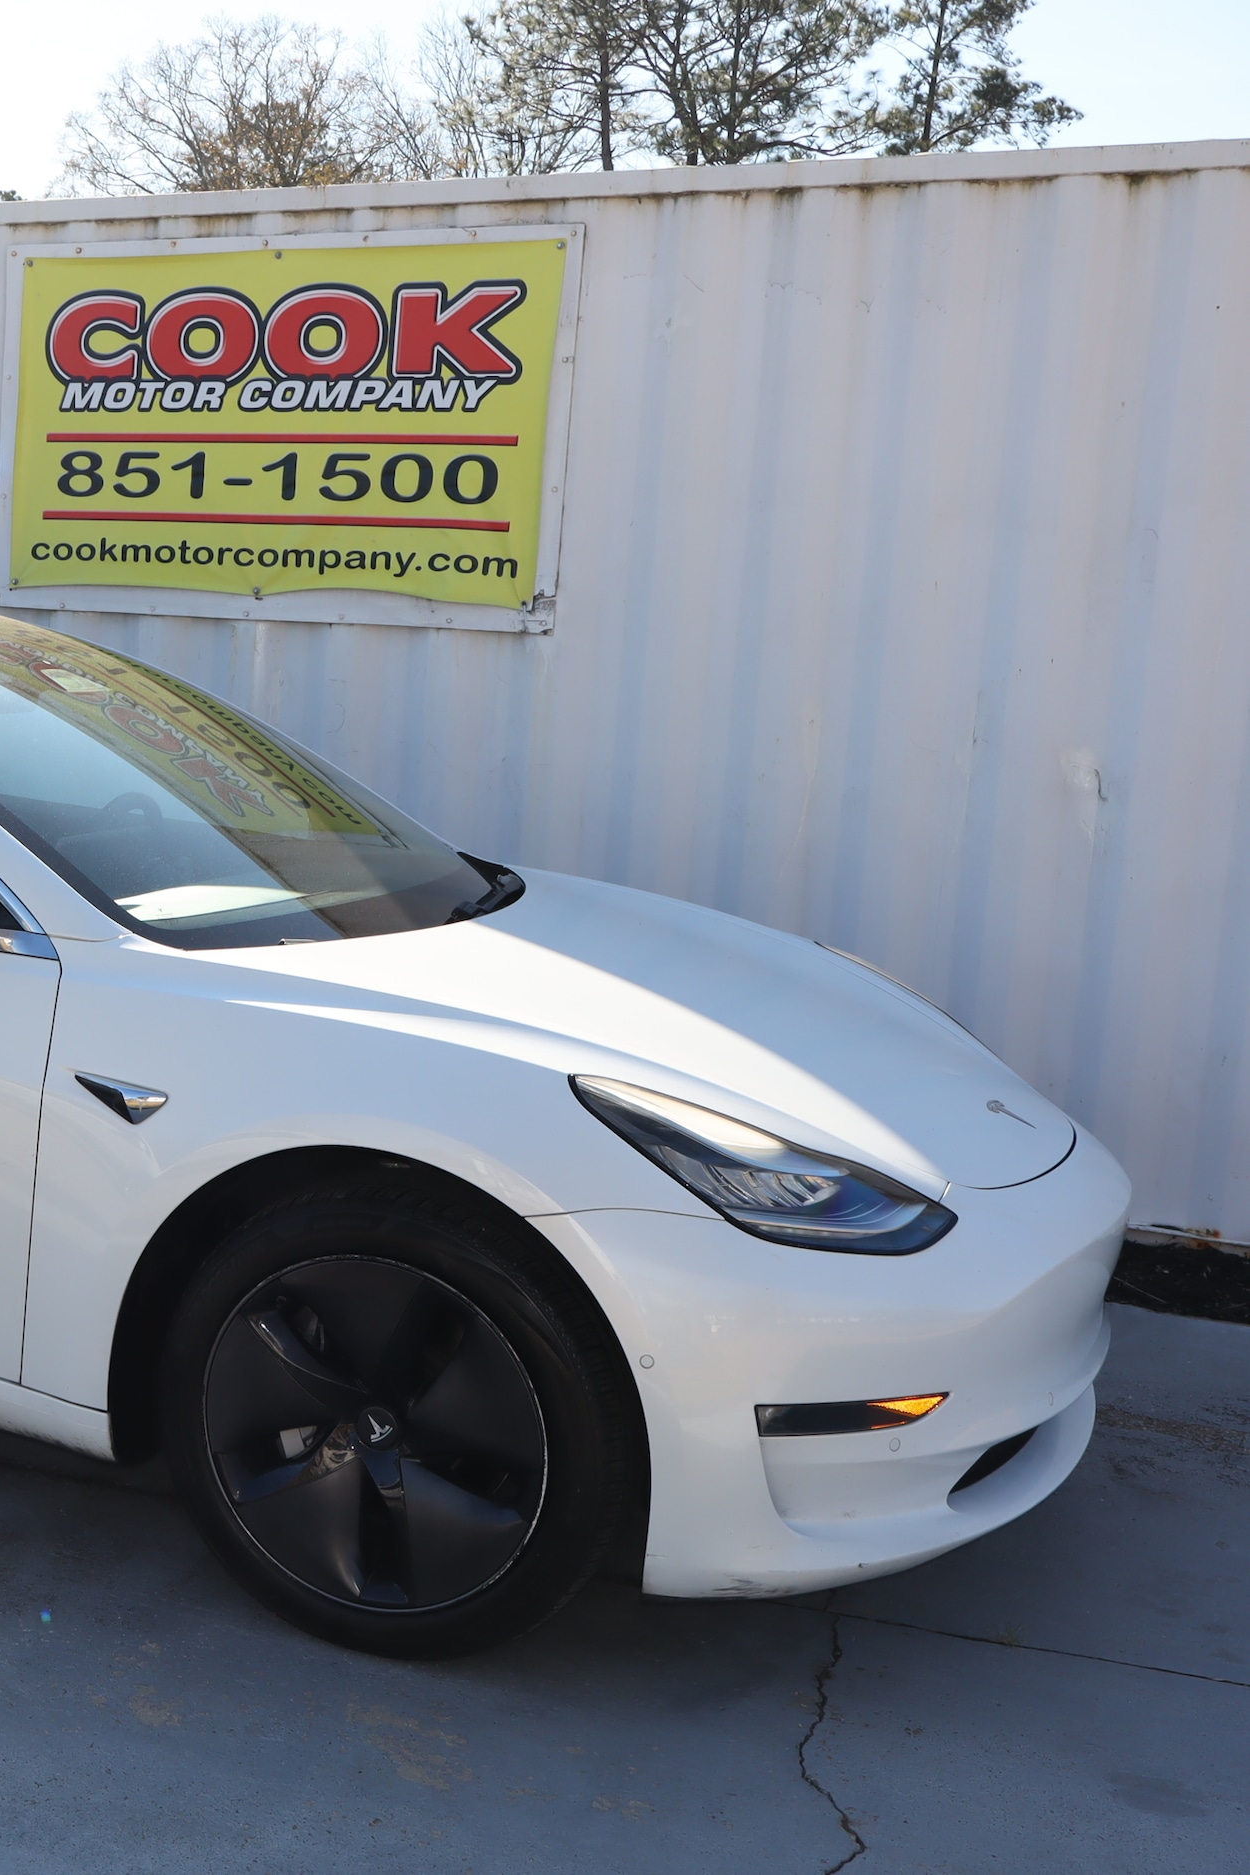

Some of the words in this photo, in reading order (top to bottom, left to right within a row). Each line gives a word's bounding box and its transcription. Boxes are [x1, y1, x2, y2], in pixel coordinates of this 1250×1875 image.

[45, 278, 527, 385] COOK
[59, 378, 228, 413] MOTOR
[235, 375, 500, 413] COMPANY
[56, 449, 500, 505] 851-1500
[29, 536, 519, 579] cookmotorcompany.com
